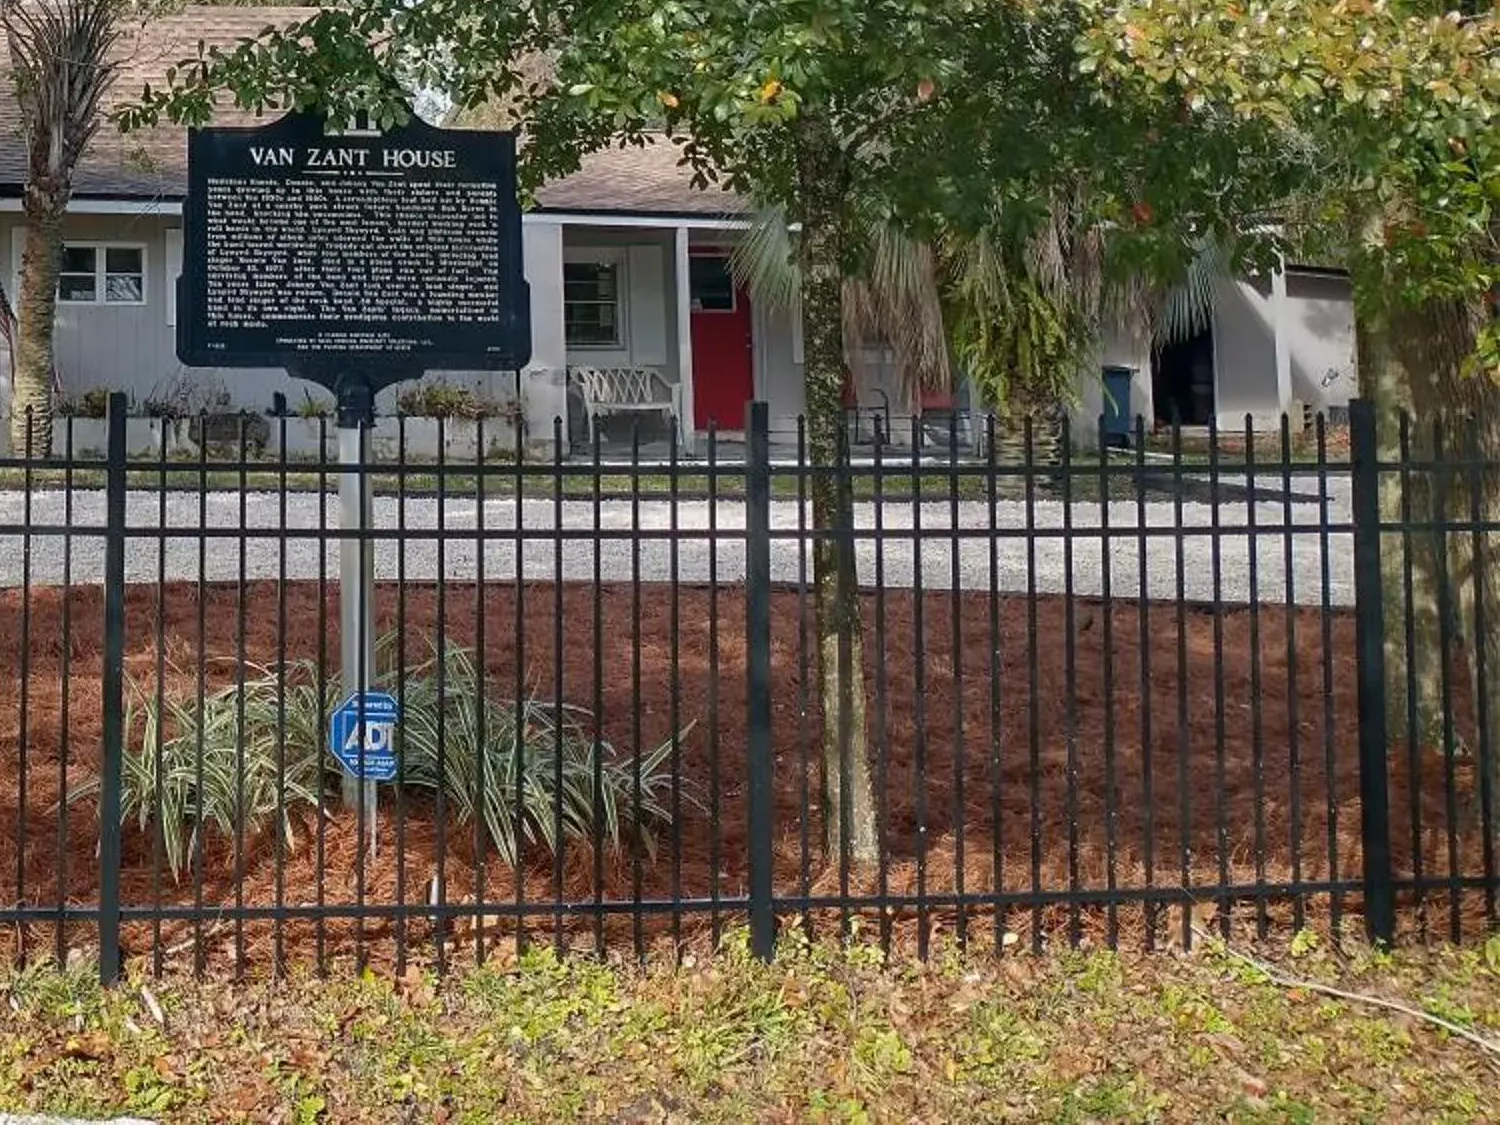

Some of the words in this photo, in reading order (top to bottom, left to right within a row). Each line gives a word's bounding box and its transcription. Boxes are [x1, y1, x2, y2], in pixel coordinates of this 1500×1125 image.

[249, 147, 295, 166] VAN
[307, 148, 370, 167] ZANT
[383, 149, 457, 168] HOUSE
[345, 721, 394, 752] ADT
